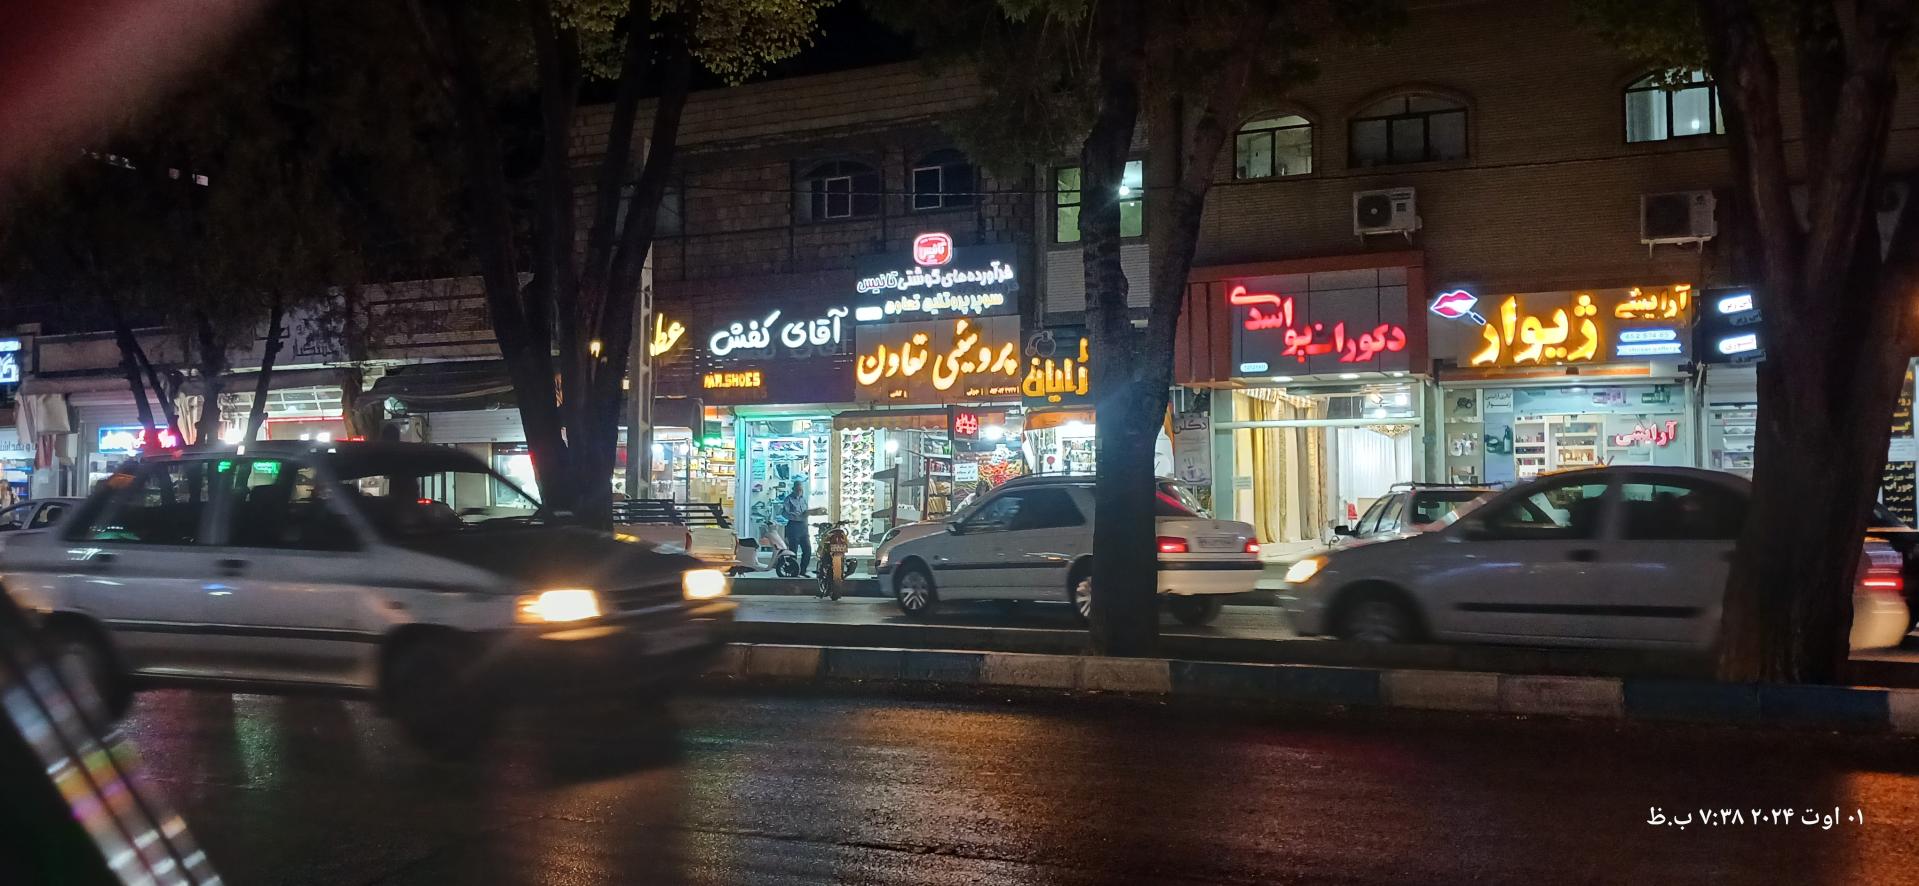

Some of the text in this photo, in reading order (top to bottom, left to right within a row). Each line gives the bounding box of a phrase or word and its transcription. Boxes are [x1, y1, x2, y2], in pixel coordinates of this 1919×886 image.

[856, 270, 899, 294] تانیس
[1614, 284, 1692, 319] آرایشی
[709, 305, 849, 357] آقای کفش
[1471, 294, 1599, 366] ژیوار
[856, 332, 928, 386] تعاون
[1616, 420, 1678, 448] آرایشی
